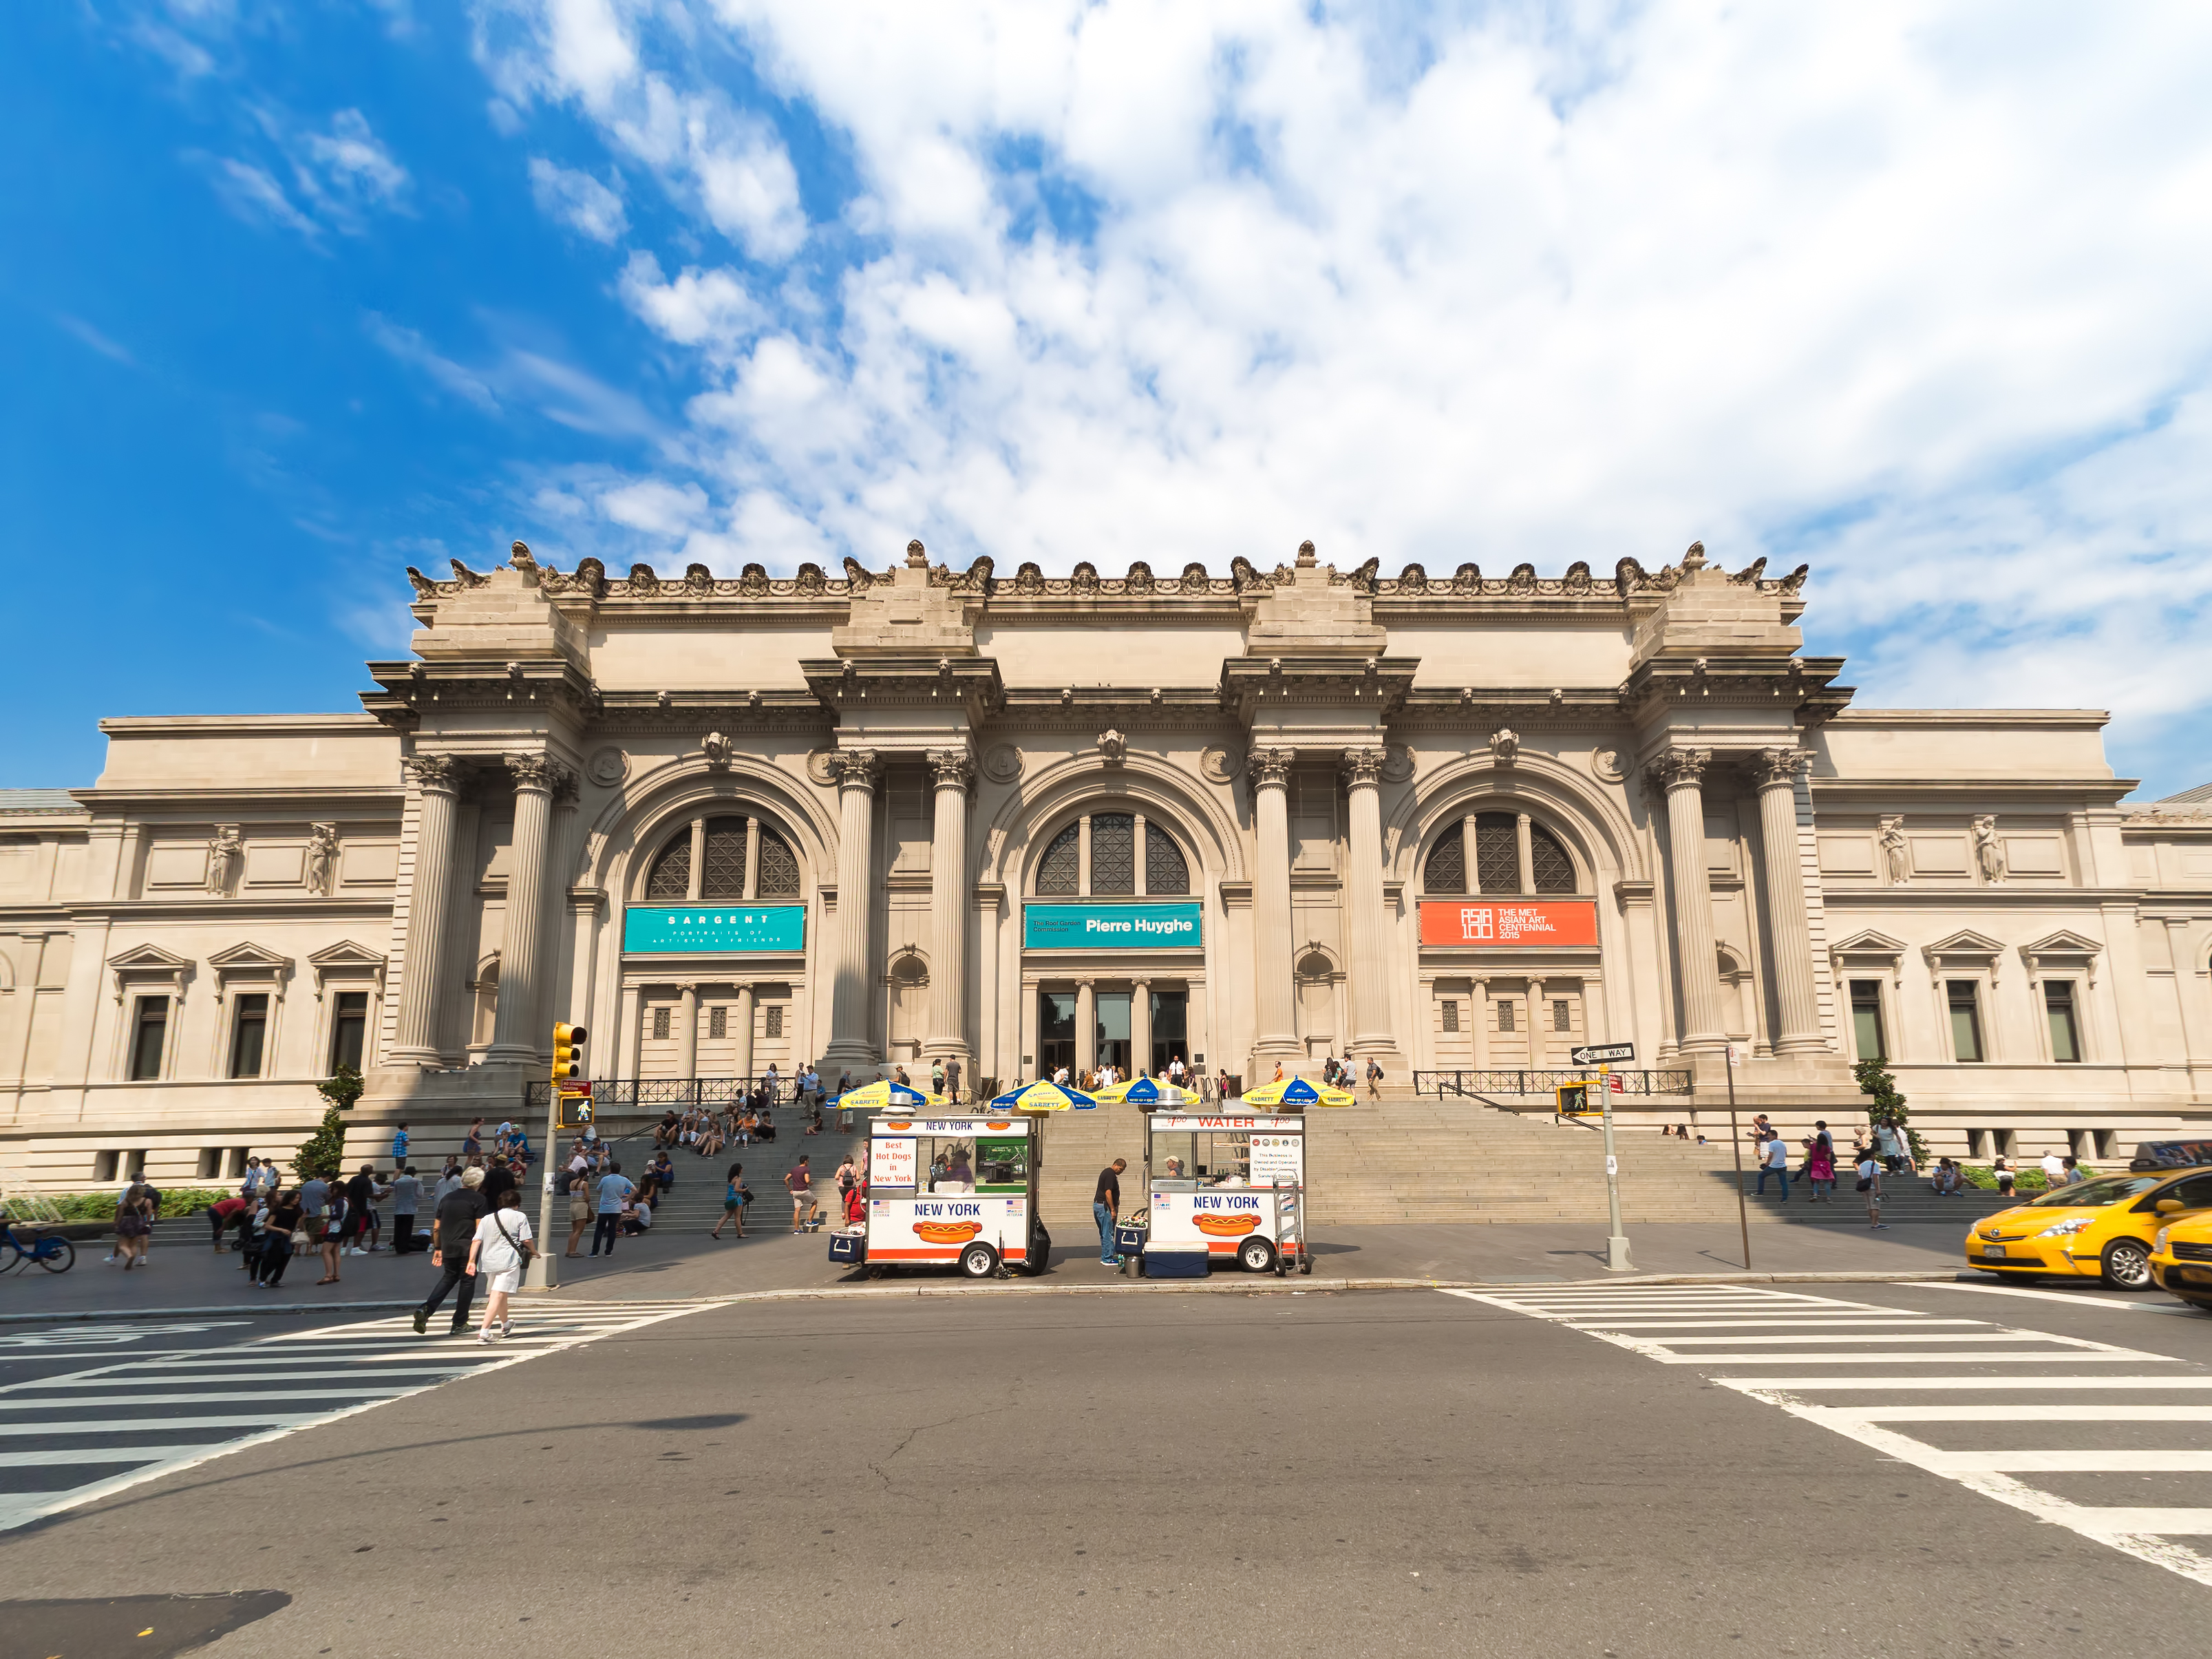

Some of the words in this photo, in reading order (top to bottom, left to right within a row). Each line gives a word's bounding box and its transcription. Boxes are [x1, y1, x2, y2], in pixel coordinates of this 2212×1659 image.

[668, 916, 768, 924] SARGENT
[1461, 909, 1492, 923] ASIA
[1086, 920, 1131, 932] Pierre
[1134, 919, 1193, 934] Huyghe
[1462, 923, 1493, 939] 100
[1580, 1051, 1597, 1059] ONE
[1608, 1048, 1627, 1057] WAY
[926, 1122, 946, 1130] NEW
[950, 1122, 972, 1130] YORK
[1167, 1117, 1187, 1127] $1.00
[1198, 1117, 1255, 1127] WATER
[1270, 1117, 1290, 1128] $1.00
[1194, 1196, 1222, 1208] NEW
[1226, 1196, 1259, 1208] YORK
[915, 1204, 942, 1216] NEW
[948, 1204, 980, 1216] YORK
